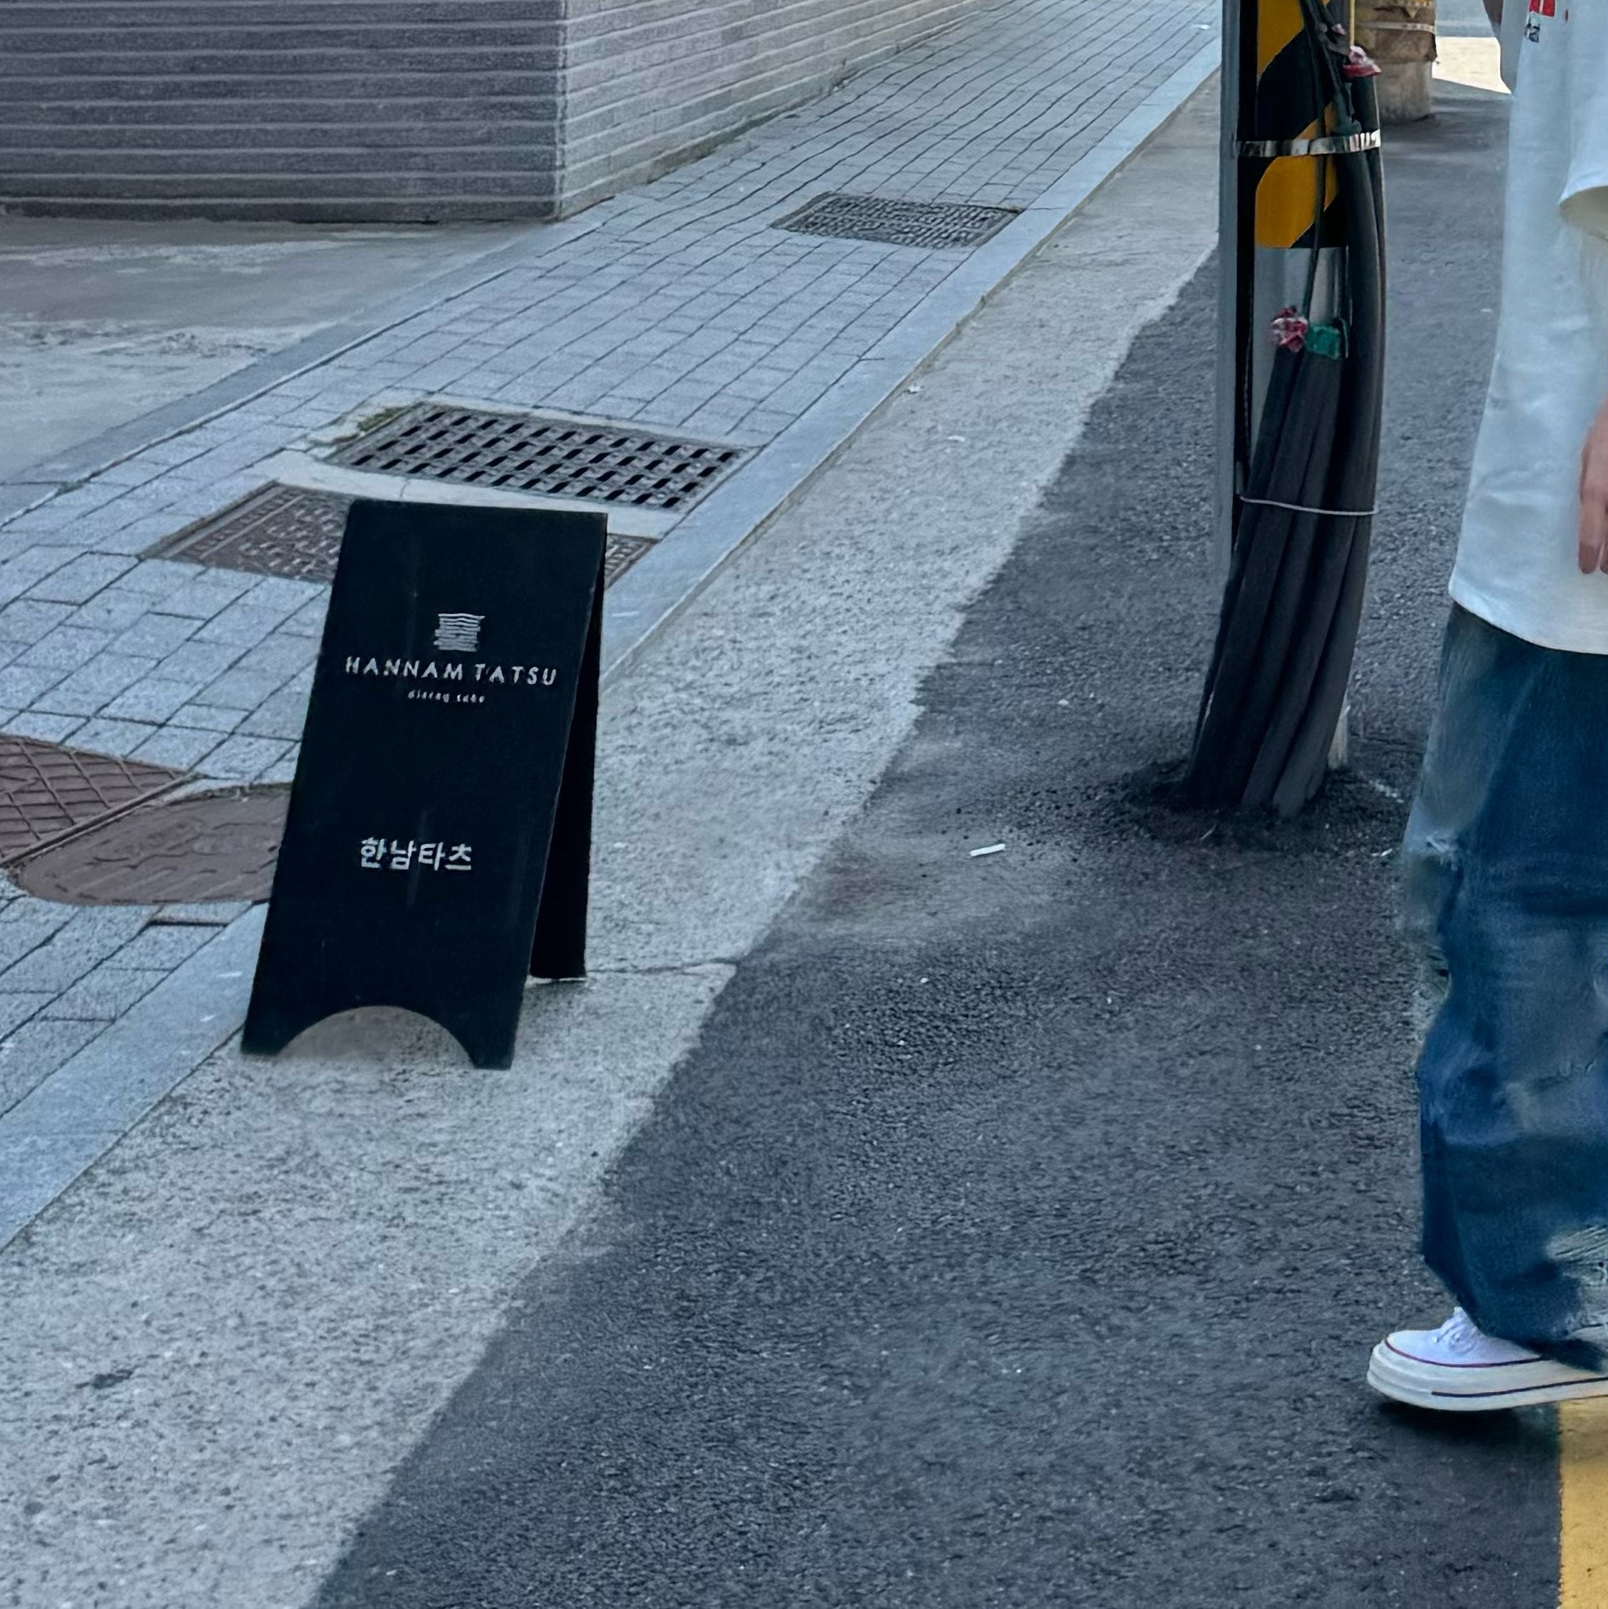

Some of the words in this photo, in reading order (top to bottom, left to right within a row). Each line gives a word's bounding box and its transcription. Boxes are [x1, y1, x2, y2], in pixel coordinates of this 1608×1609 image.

[344, 655, 463, 681] HANNAM
[474, 662, 557, 686] TATSU
[360, 836, 472, 871] 한남타츠
